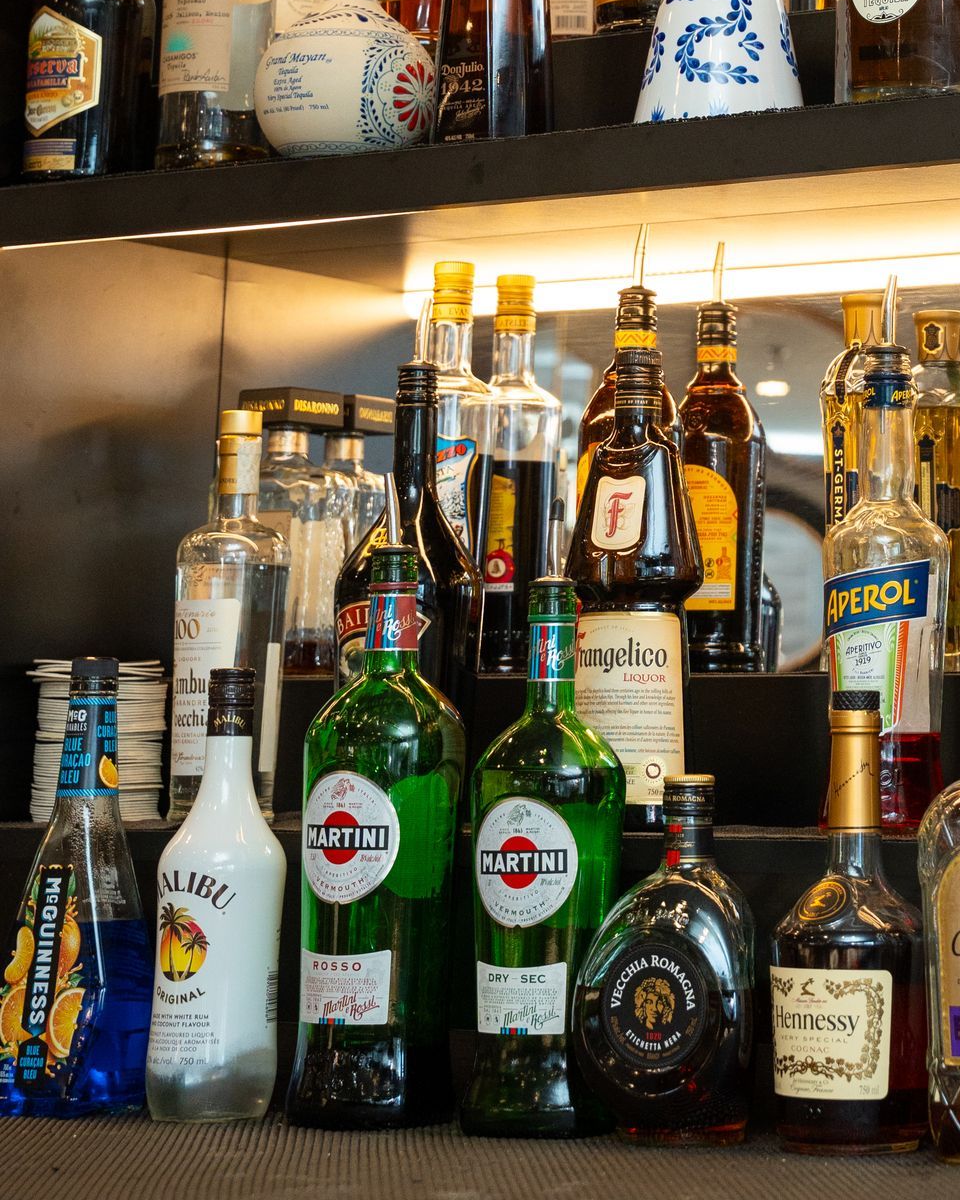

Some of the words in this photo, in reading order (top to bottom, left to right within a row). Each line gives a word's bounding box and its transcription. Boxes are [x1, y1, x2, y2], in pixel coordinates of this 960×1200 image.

[265, 52, 290, 70] Grand
[289, 52, 326, 66] Mayan
[441, 79, 483, 96] 1942
[294, 399, 340, 416] DISARONNO
[833, 448, 846, 528] ST-GERMA
[826, 578, 916, 627] APEROL
[846, 640, 882, 656] APERITIVO
[855, 656, 872, 667] 1919
[623, 672, 666, 683] LIQUOR
[213, 714, 246, 729] MALIBU
[64, 738, 83, 751] BLUE
[308, 827, 386, 848] MARTINI
[482, 851, 565, 873] MARTINI
[316, 876, 365, 892] VERMOUTH
[494, 900, 546, 916] VERMOUTH
[29, 877, 62, 1026] McGUINNESS
[312, 960, 362, 971] ROSSO
[488, 973, 509, 984] DRY
[520, 973, 546, 984] SEC
[610, 957, 649, 1009] VECCHIA
[650, 954, 696, 1011] ROMAGNA
[156, 986, 206, 1005] ORIGINAL
[775, 1005, 860, 1037] Hennessy
[625, 1029, 662, 1050] ETICHETTA
[664, 1031, 682, 1048] NERA
[802, 1036, 848, 1044] SPECIAL
[26, 1045, 40, 1056] BLUE
[791, 1046, 829, 1054] COGNAC
[19, 1057, 44, 1070] CURAÇAO
[179, 1057, 194, 1066] 750
[23, 1069, 37, 1080] BLEU
